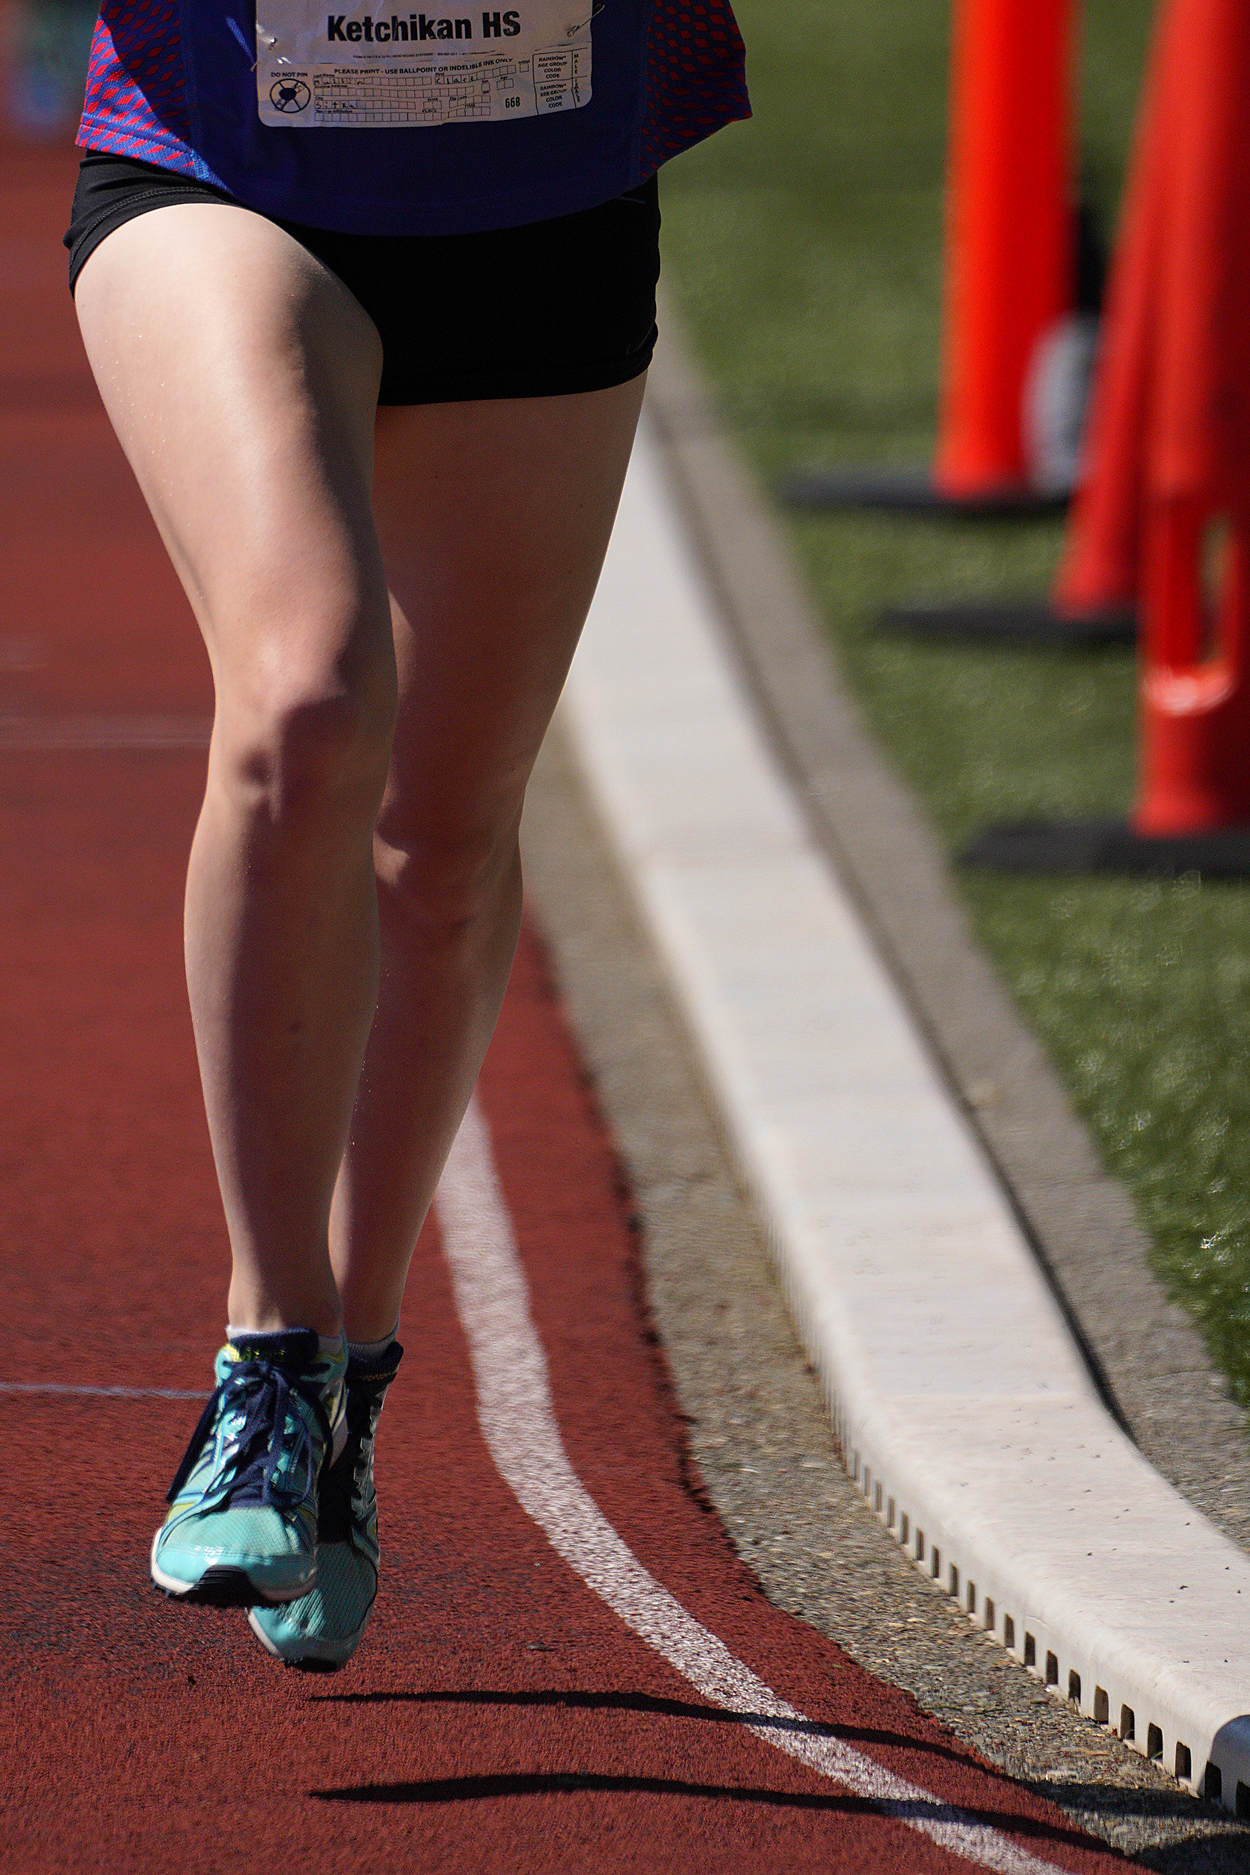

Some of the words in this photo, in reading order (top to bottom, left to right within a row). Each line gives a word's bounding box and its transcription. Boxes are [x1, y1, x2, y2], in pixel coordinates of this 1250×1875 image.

[327, 14, 473, 43] Ketchikan
[482, 10, 522, 39] HS
[399, 66, 438, 75] BALLPOINT
[449, 62, 482, 72] INDELIBLE
[483, 59, 495, 67] INK
[495, 57, 514, 65] ONLY
[505, 96, 521, 108] 668
[546, 95, 563, 103] COLOR
